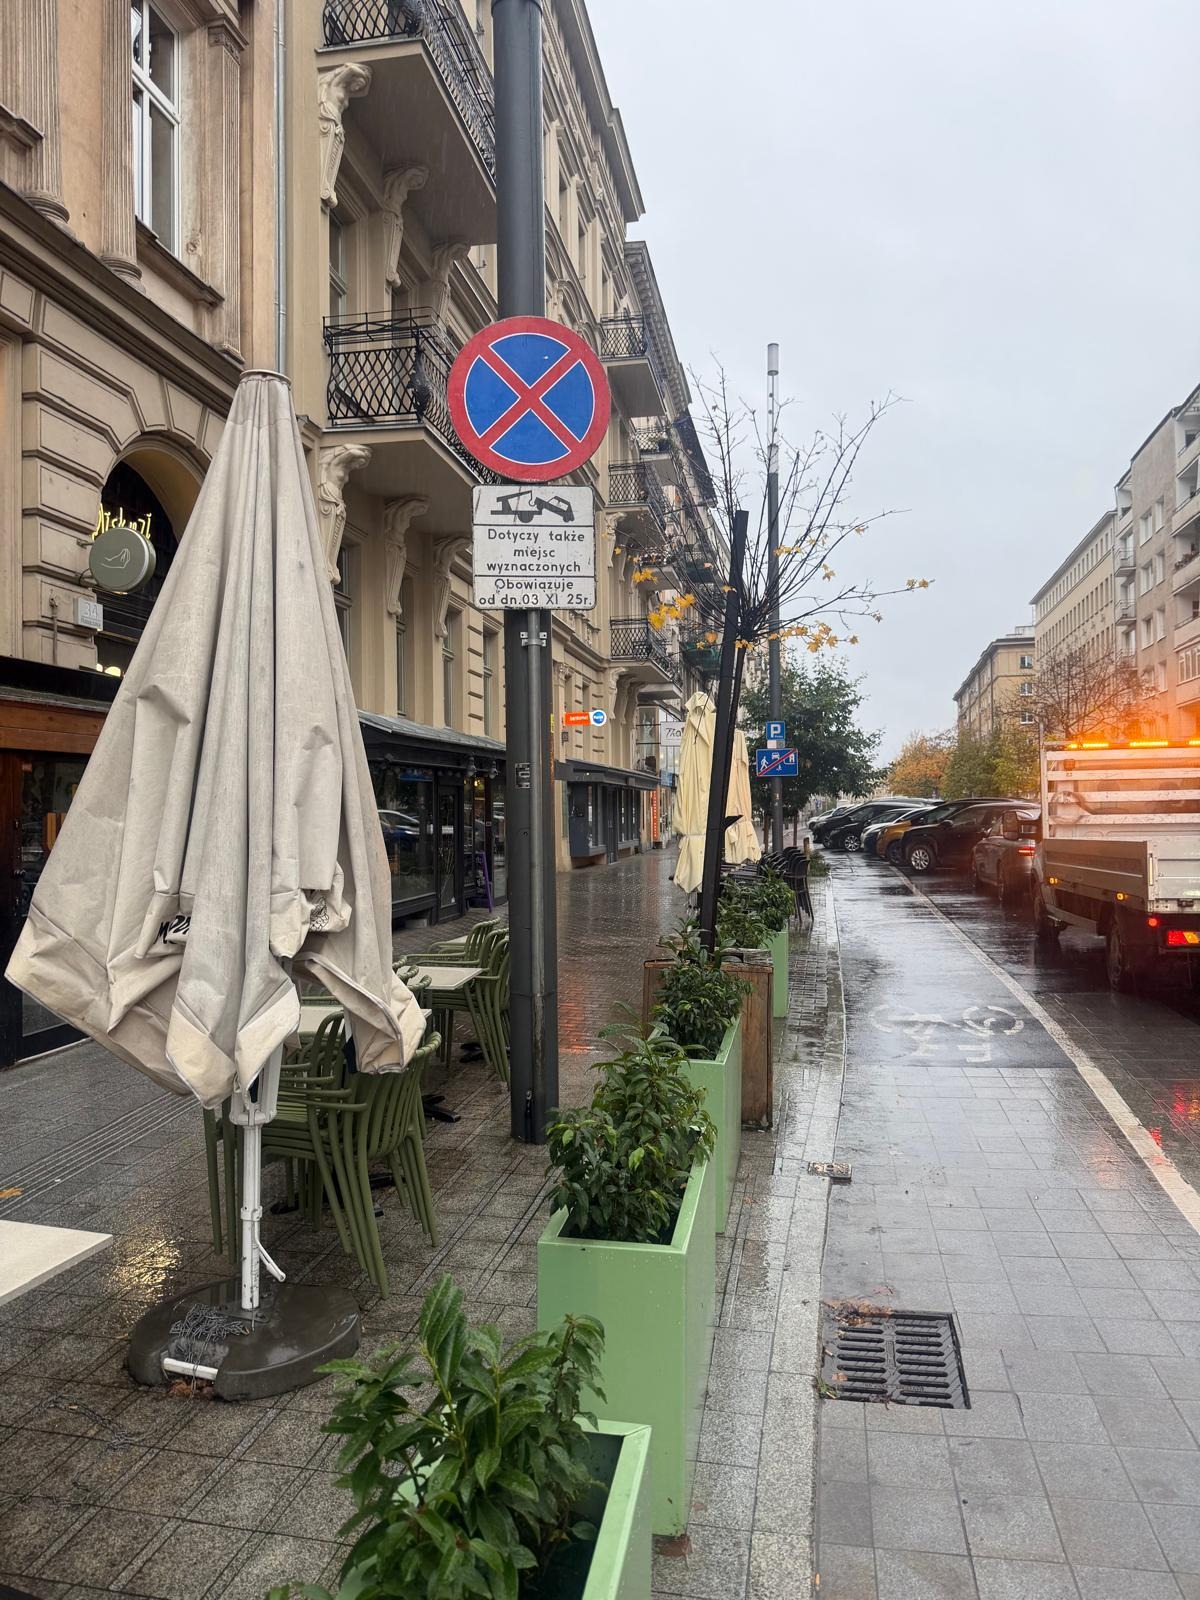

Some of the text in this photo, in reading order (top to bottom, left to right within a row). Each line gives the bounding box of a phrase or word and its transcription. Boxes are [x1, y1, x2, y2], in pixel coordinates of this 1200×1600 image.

[488, 528, 585, 543] Dotyczy także
[513, 546, 555, 560] miejsc
[487, 561, 580, 575] wyznaczonych
[479, 594, 495, 605] od
[546, 594, 558, 605] XI
[770, 724, 781, 738] P
